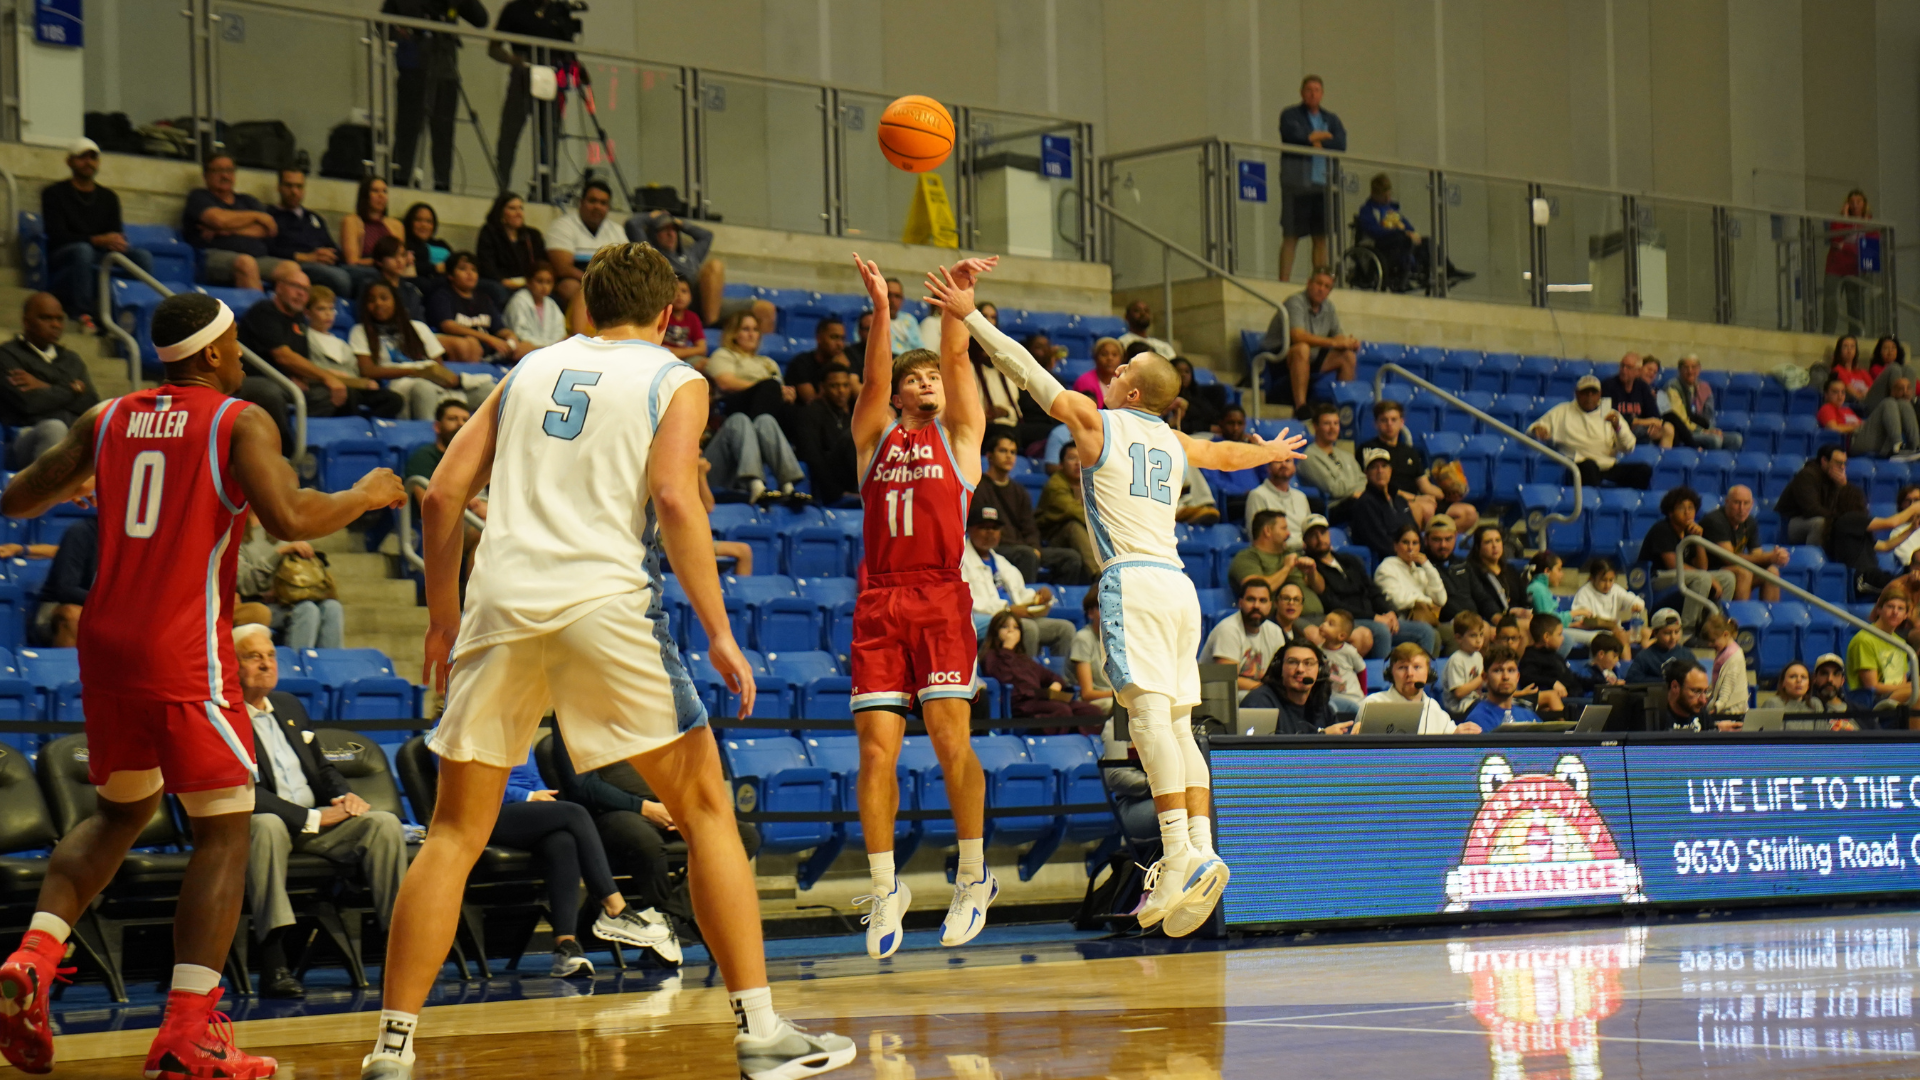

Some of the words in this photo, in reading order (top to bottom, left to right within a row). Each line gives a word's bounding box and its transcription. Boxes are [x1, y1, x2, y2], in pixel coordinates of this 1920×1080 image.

[126, 410, 189, 438] MILLER
[542, 368, 603, 441] 5
[125, 450, 166, 539] 0
[1128, 441, 1173, 505] 12
[885, 488, 914, 538] 11
[1688, 778, 1745, 813] LIVE
[1751, 776, 1807, 811] LIFE
[1812, 776, 1848, 810] TO
[1853, 776, 1904, 809] THE
[1673, 838, 1740, 874] 9630
[1747, 836, 1832, 875] Stirling
[1838, 832, 1906, 871] Road,
[1469, 867, 1567, 894] ITALIAN
[1577, 863, 1615, 889] ICE
